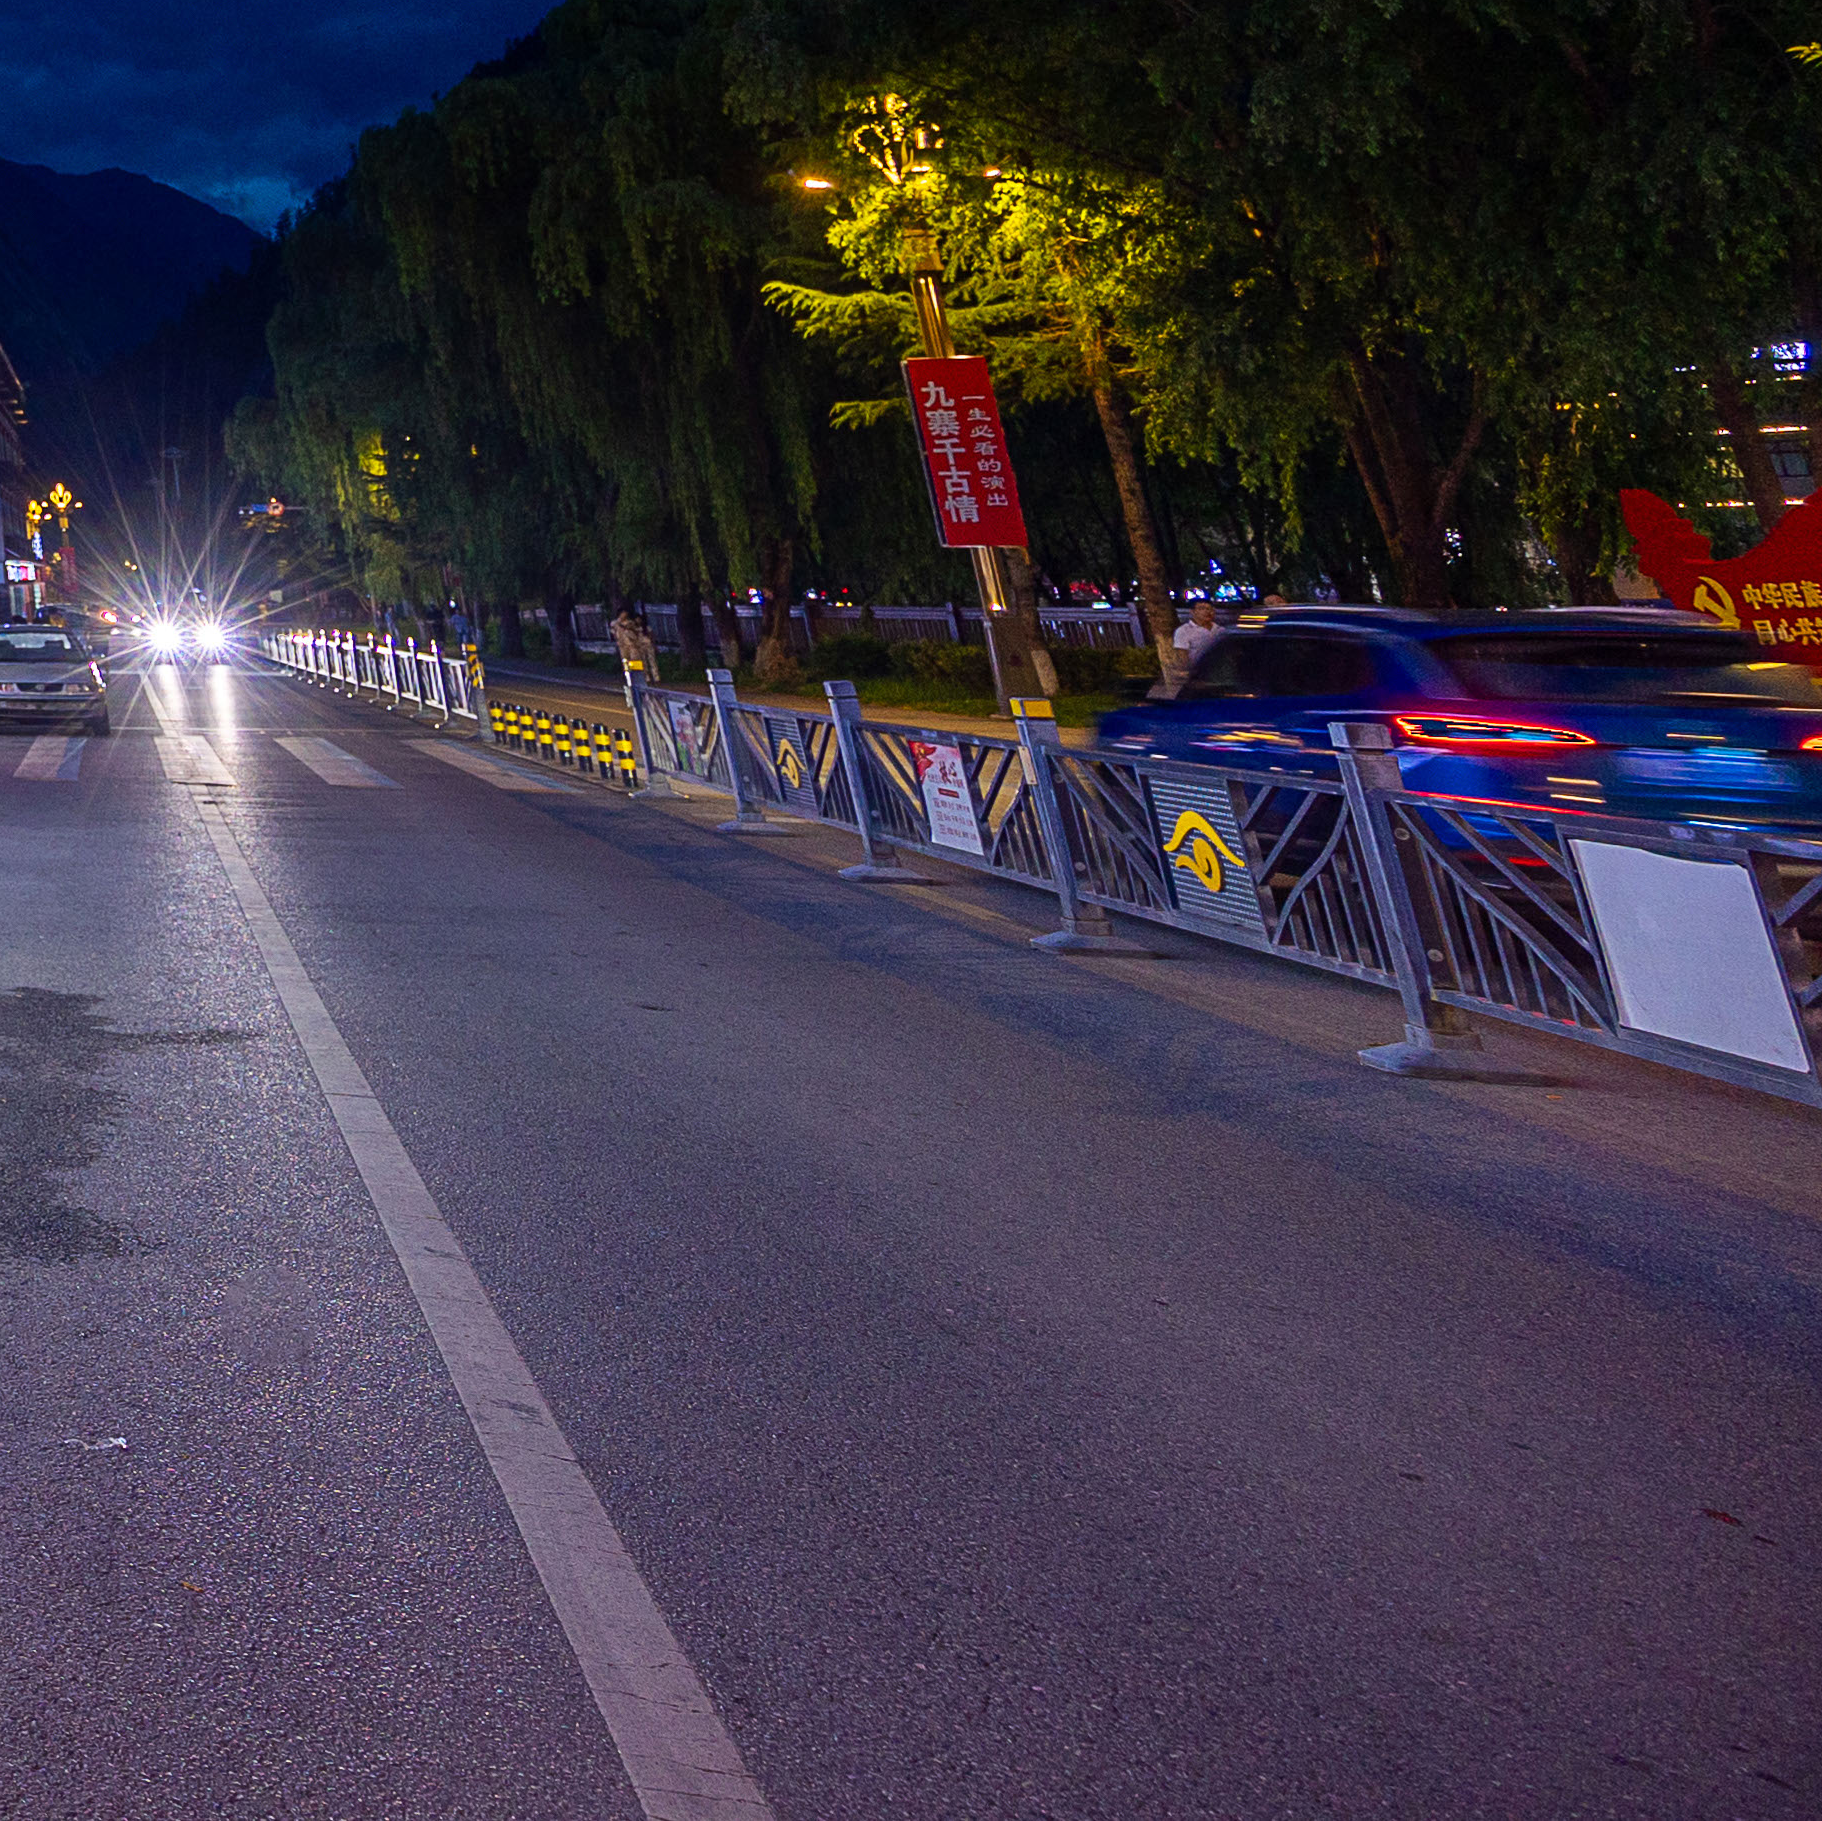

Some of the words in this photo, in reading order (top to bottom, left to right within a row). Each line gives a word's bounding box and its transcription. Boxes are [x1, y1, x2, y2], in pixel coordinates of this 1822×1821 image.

[920, 381, 979, 523] 九寨千古情
[961, 395, 1008, 507] 一生必看的演出
[1741, 579, 1822, 610] 中华民族
